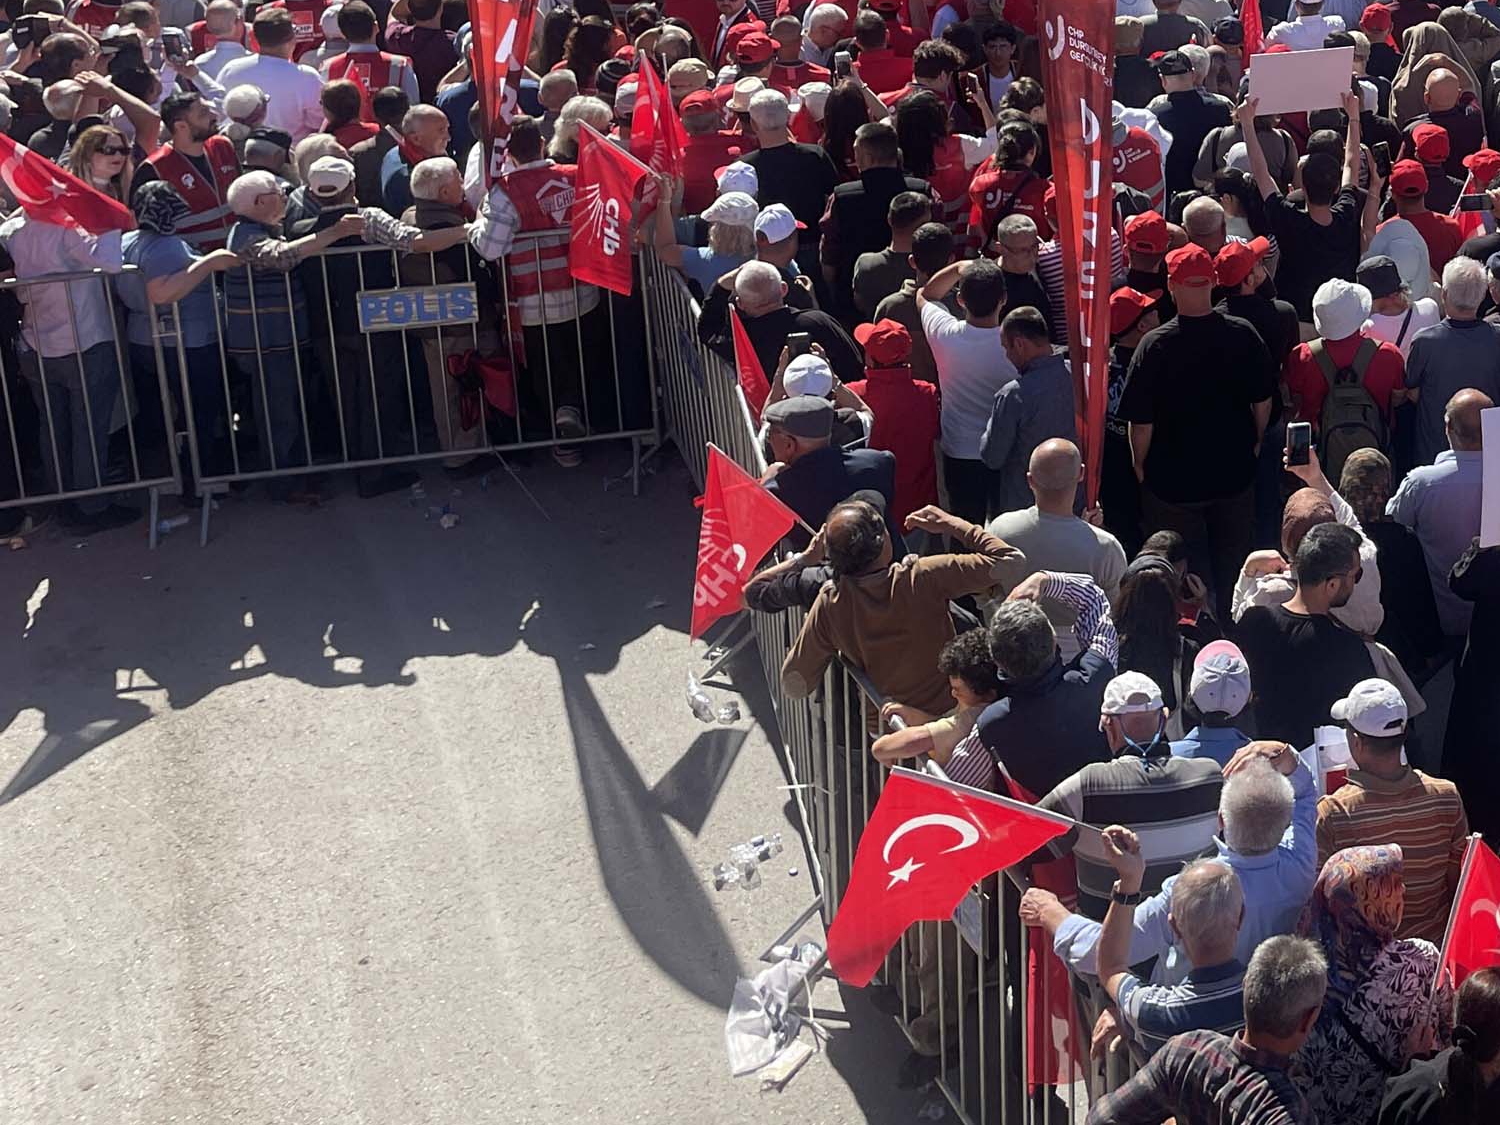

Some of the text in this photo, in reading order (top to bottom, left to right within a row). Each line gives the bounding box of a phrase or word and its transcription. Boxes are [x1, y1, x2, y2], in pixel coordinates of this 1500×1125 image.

[1068, 26, 1084, 38] CHP
[556, 189, 575, 207] CHP
[603, 198, 621, 256] CHP
[693, 543, 747, 607] CHP
